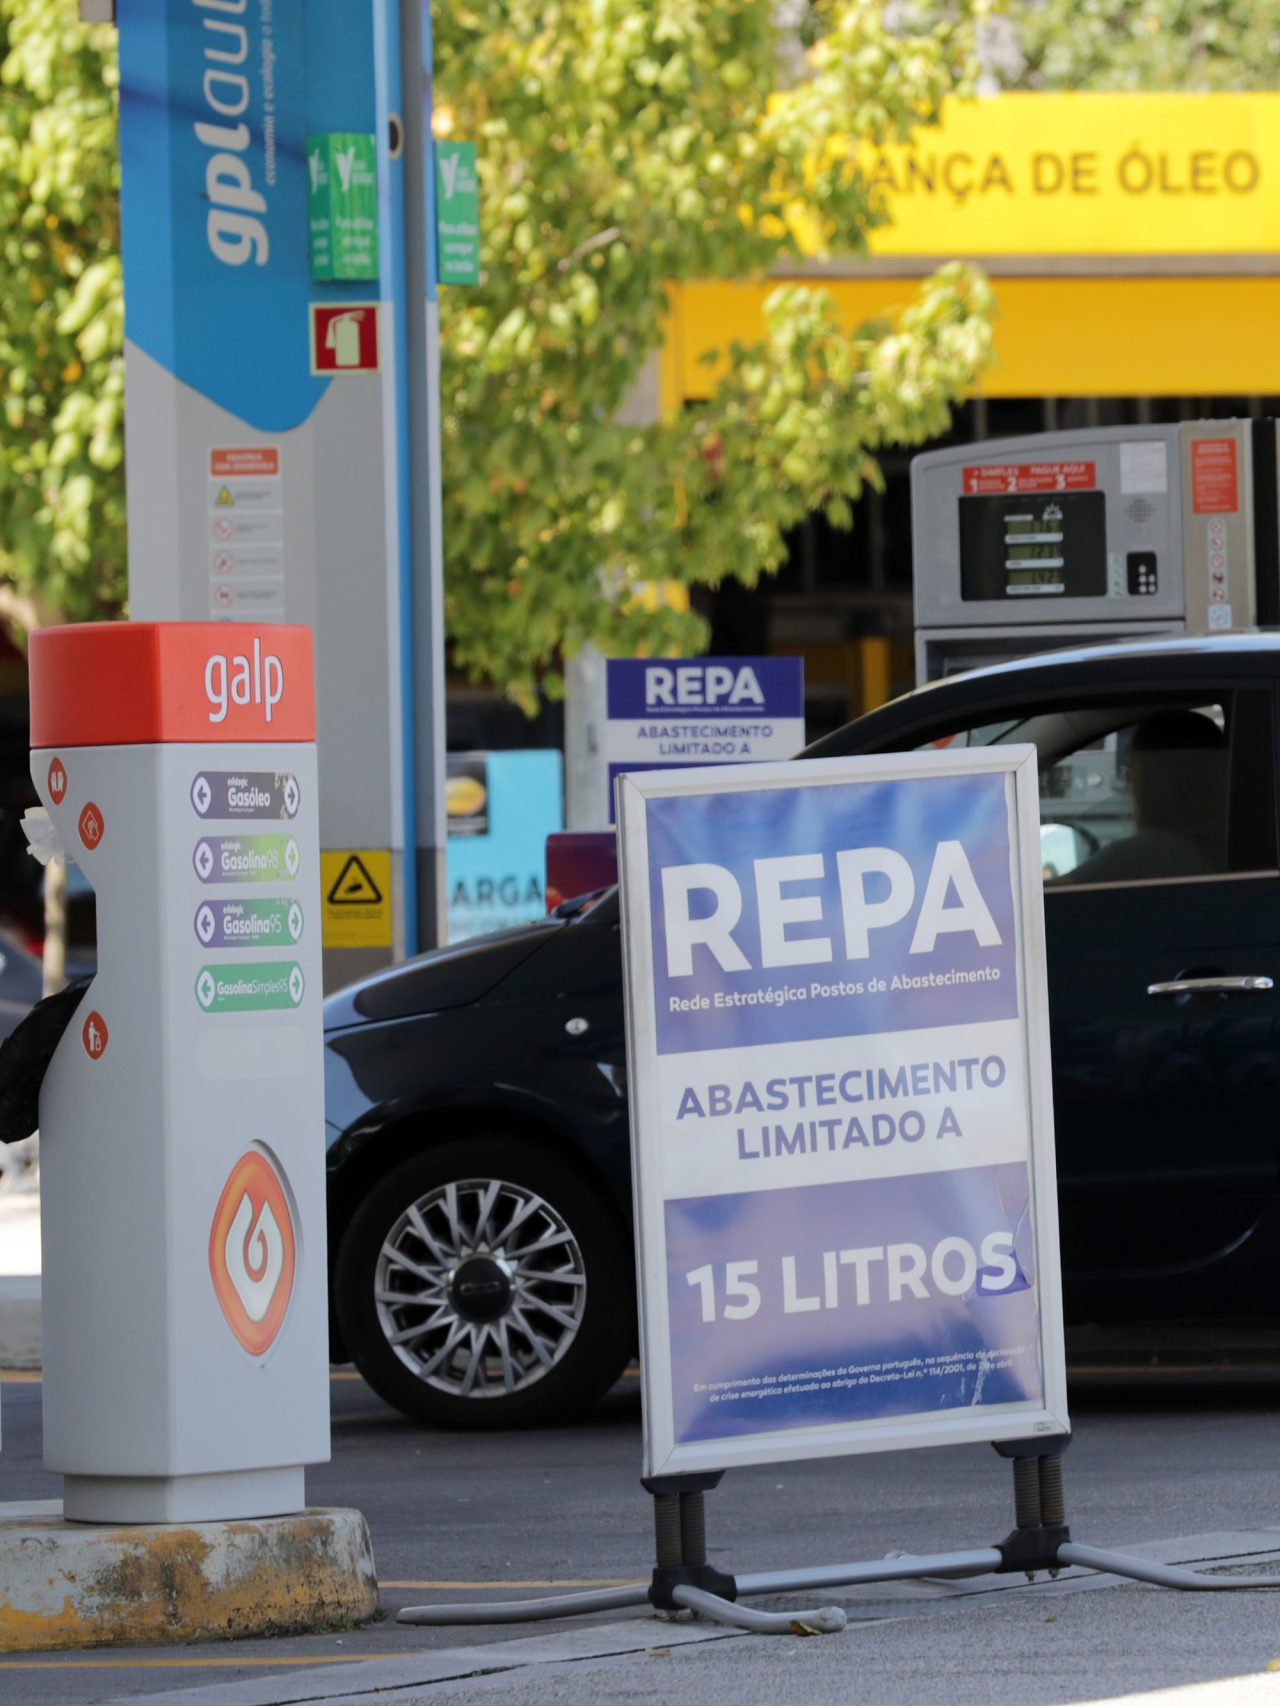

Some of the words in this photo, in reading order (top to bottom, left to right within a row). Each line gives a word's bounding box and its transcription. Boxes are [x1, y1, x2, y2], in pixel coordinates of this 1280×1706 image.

[1031, 151, 1099, 196] DE
[1117, 140, 1261, 196] ÓLEO
[204, 636, 285, 723] galp
[645, 666, 766, 706] REPA
[637, 724, 773, 739] ABASTECIMENTO
[659, 742, 736, 756] LIMITADO
[740, 743, 752, 755] A
[227, 786, 271, 807] Gasóleo
[221, 848, 279, 871] Gasolina98
[223, 913, 283, 934] Gasolina95
[660, 840, 1003, 978] REPA
[217, 978, 289, 997] GasolinaSimples95
[669, 994, 710, 1012] Rede
[714, 985, 806, 1009] Estratégica
[811, 980, 864, 999] Postos
[867, 976, 887, 993] de
[891, 965, 1001, 991] Abastecimento
[676, 1055, 1006, 1120] ABASTECIMENTO
[736, 1110, 926, 1160] LIMITADO
[936, 1107, 963, 1139] A
[685, 1260, 760, 1322] 15
[781, 1231, 1017, 1313] LITROS
[694, 1383, 707, 1392] Em
[708, 1377, 761, 1390] cumprimento
[762, 1375, 777, 1385] das
[778, 1369, 836, 1382] determinações
[837, 1366, 848, 1375] do
[848, 1365, 881, 1374] Governo
[882, 1357, 924, 1370] português,
[936, 1351, 974, 1364] sequência
[709, 1393, 719, 1402] de
[721, 1391, 739, 1401] crise
[741, 1386, 782, 1399] energética
[821, 1381, 831, 1389] ao
[832, 1378, 857, 1389] abrigo
[858, 1376, 868, 1385] do
[870, 1370, 915, 1383] Decreto-Lei
[966, 1362, 977, 1371] de
